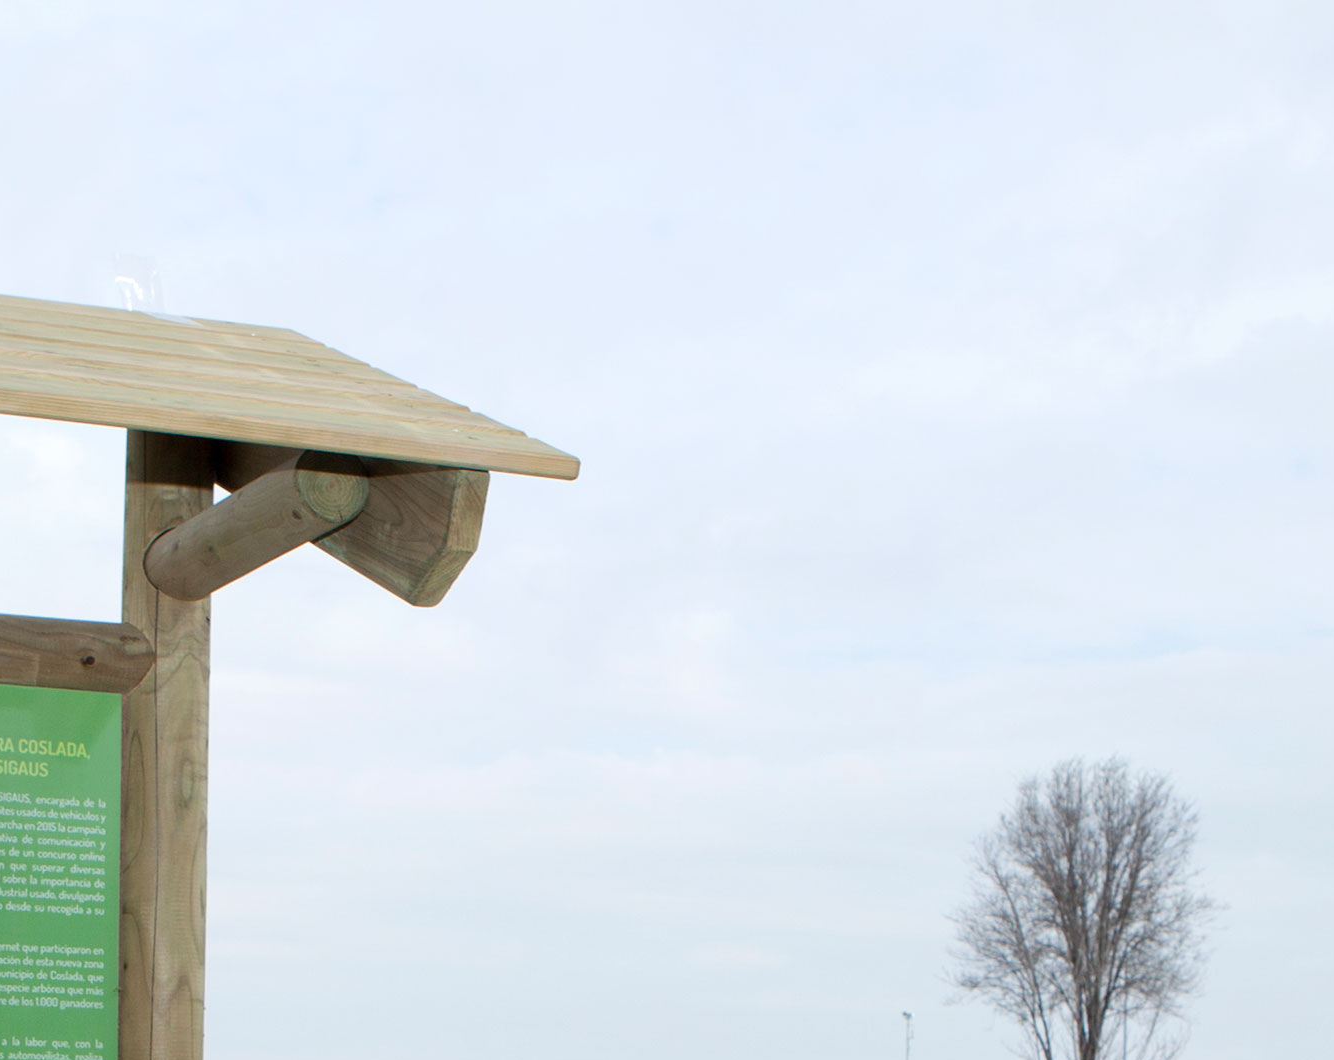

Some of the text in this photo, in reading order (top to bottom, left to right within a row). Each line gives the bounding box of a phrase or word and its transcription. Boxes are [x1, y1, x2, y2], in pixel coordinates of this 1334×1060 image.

[9, 862, 27, 872] que
[31, 863, 65, 874] superar
[69, 863, 105, 875] diversas
